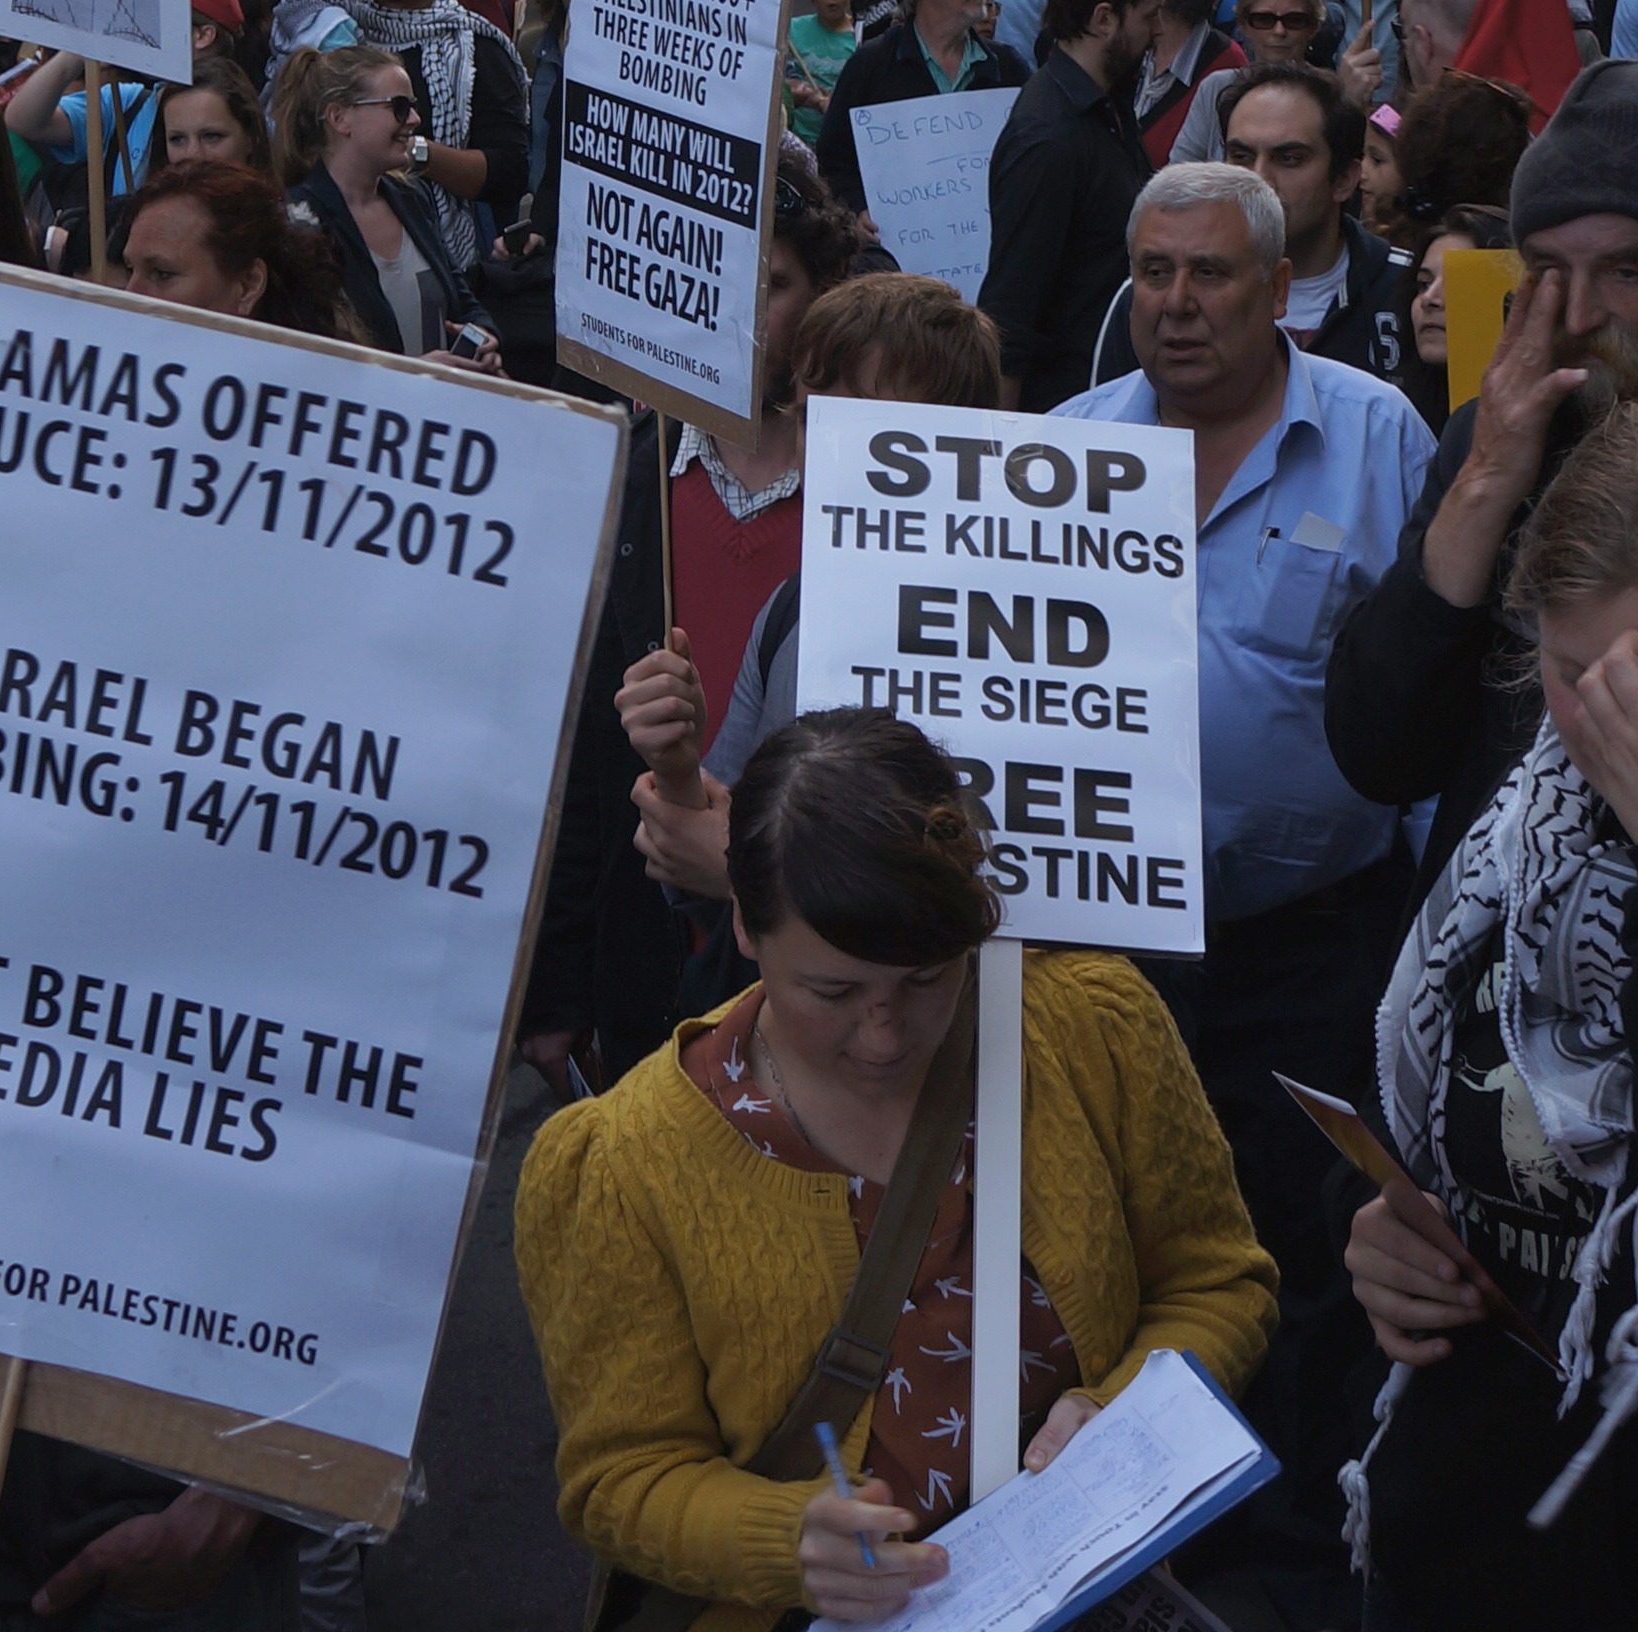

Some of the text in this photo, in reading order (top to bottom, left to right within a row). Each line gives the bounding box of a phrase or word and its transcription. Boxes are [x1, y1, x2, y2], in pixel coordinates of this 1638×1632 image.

[594, 7, 744, 80] THREE WEEKS OF
[728, 12, 746, 46] IN
[619, 51, 707, 106] BOMBING
[569, 121, 753, 216] ISRAEL KILL IN 2012?
[587, 93, 735, 175] HOW MANY WILL
[866, 111, 983, 145] DEFEND
[587, 181, 634, 241] NOT
[877, 178, 972, 205] WORKERS
[898, 220, 979, 246] FOR THE
[201, 372, 499, 499] OFFERED
[866, 430, 1147, 514] STOP
[148, 446, 517, 588] 13/11/2012
[822, 505, 1184, 578] THE KILLINGS
[898, 584, 1110, 669] END
[851, 666, 1149, 734] THE SIEGE
[174, 688, 400, 802] BEGAN
[158, 771, 492, 898] 14/11/2012
[962, 758, 1134, 843] REE
[988, 844, 1187, 911] STINE
[25, 963, 286, 1084] BELIEVE
[302, 1029, 425, 1121] THE
[143, 1070, 284, 1164] LIES
[58, 1271, 321, 1367] PALESTINE.ORG
